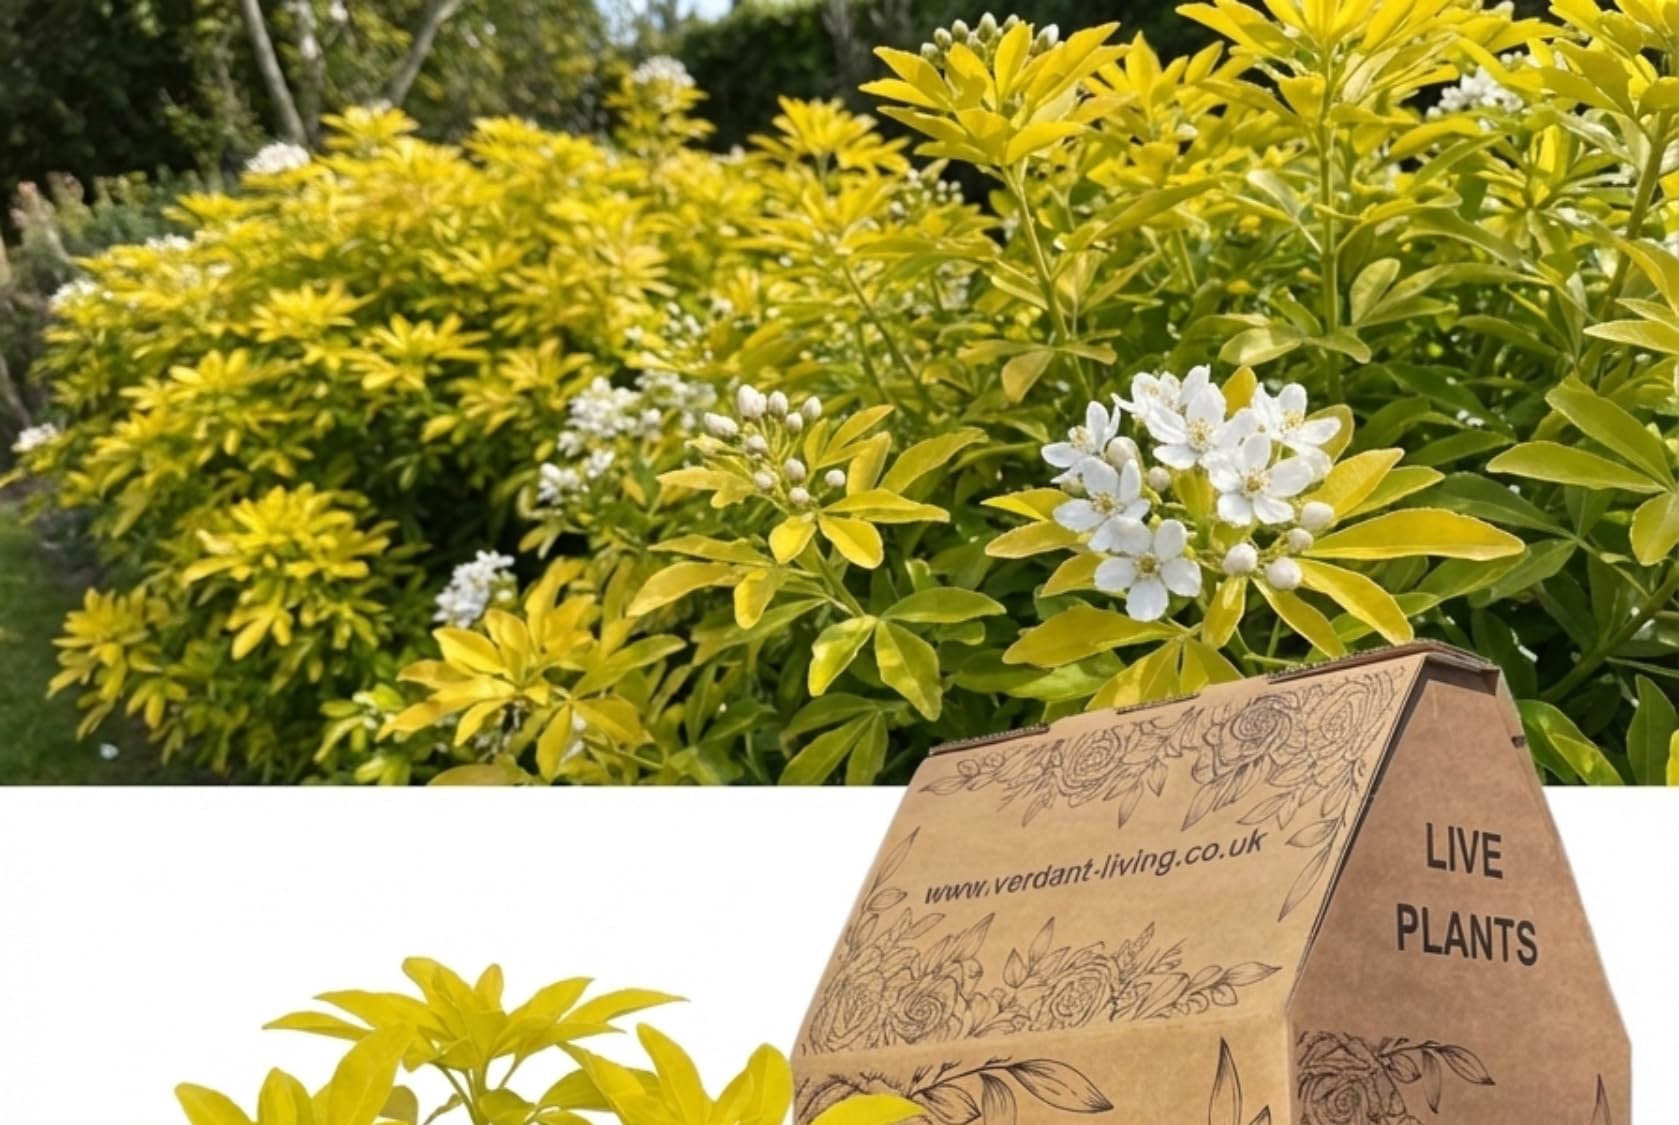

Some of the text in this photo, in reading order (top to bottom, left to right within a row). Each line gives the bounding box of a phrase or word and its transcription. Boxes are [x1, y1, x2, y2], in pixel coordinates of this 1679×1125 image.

[925, 828, 1268, 905] www.verdant-living.co.uk
[1426, 822, 1503, 879] LIVE
[1397, 903, 1537, 966] PLANTS
